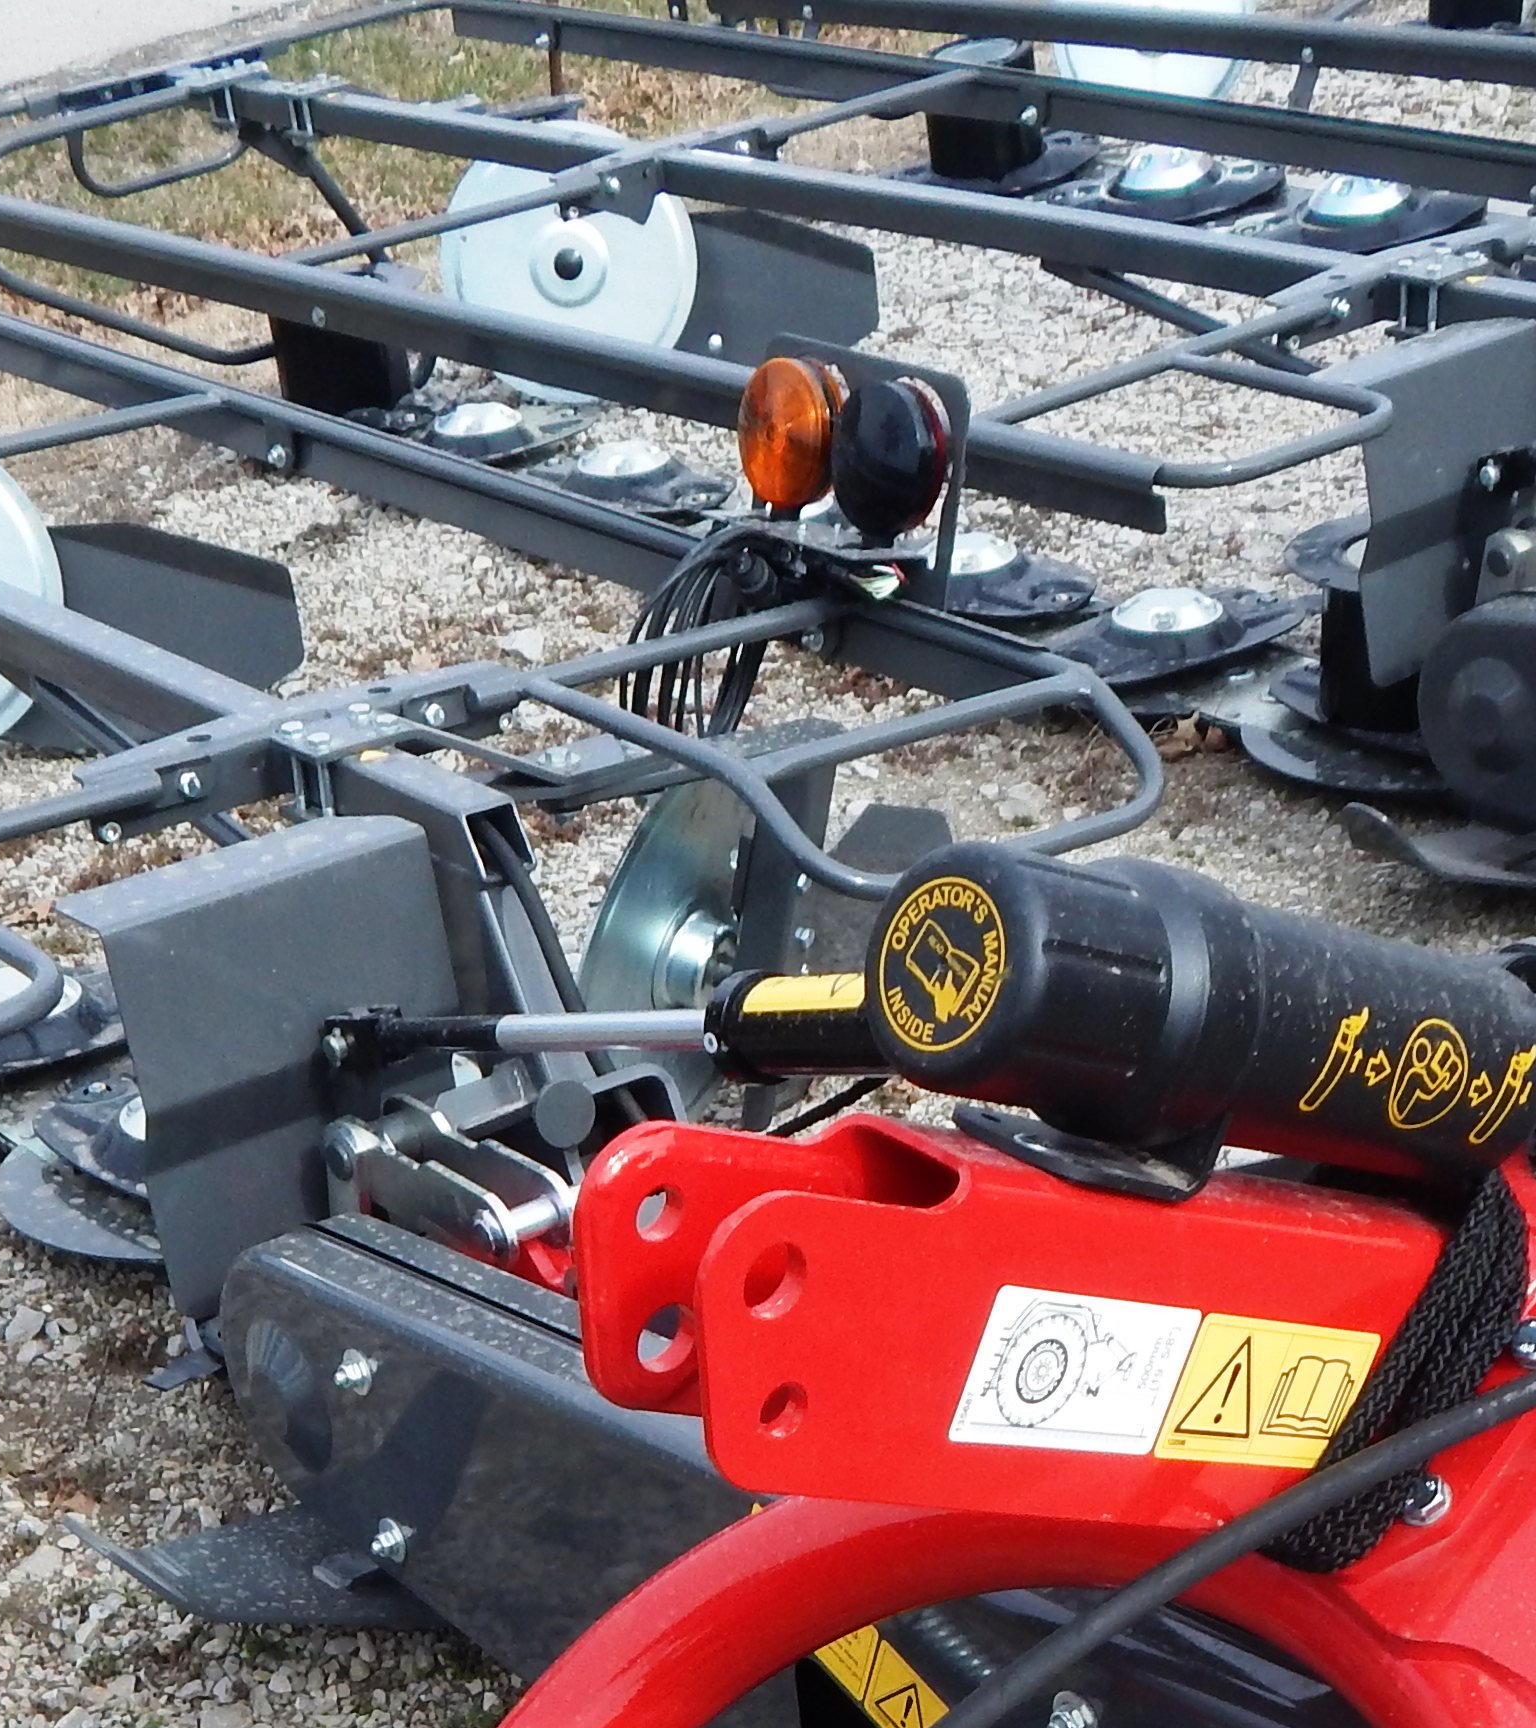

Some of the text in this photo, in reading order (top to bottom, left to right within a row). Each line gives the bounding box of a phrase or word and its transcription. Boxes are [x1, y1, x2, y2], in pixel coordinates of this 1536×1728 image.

[892, 885, 999, 1023] OPERATOR'S MANUAL
[888, 986, 935, 1042] INSIDE
[1136, 1336, 1163, 1390] 500mm
